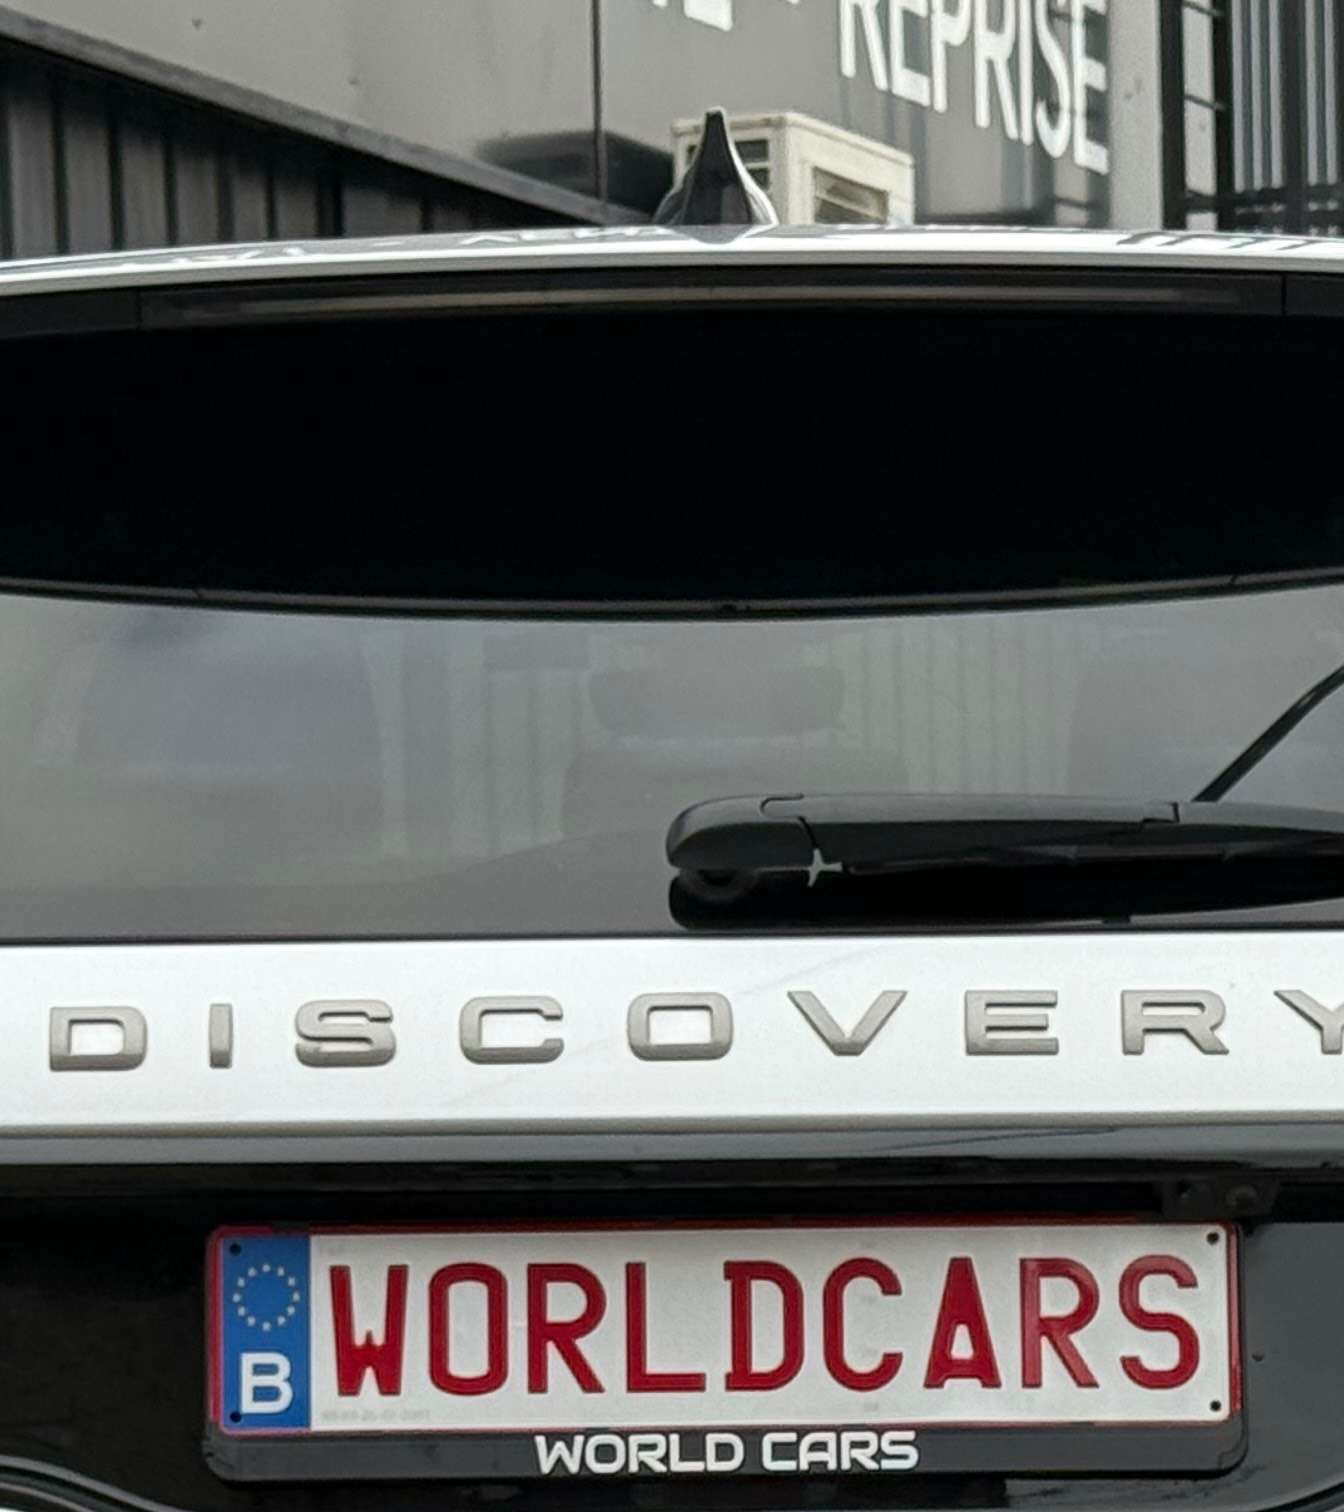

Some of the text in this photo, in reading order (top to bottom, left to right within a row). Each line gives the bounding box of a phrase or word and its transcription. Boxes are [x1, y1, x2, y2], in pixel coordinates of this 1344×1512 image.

[329, 1254, 1200, 1397] WORLDCARS
[240, 1352, 293, 1415] B
[534, 1429, 919, 1475] WORLD CARS
